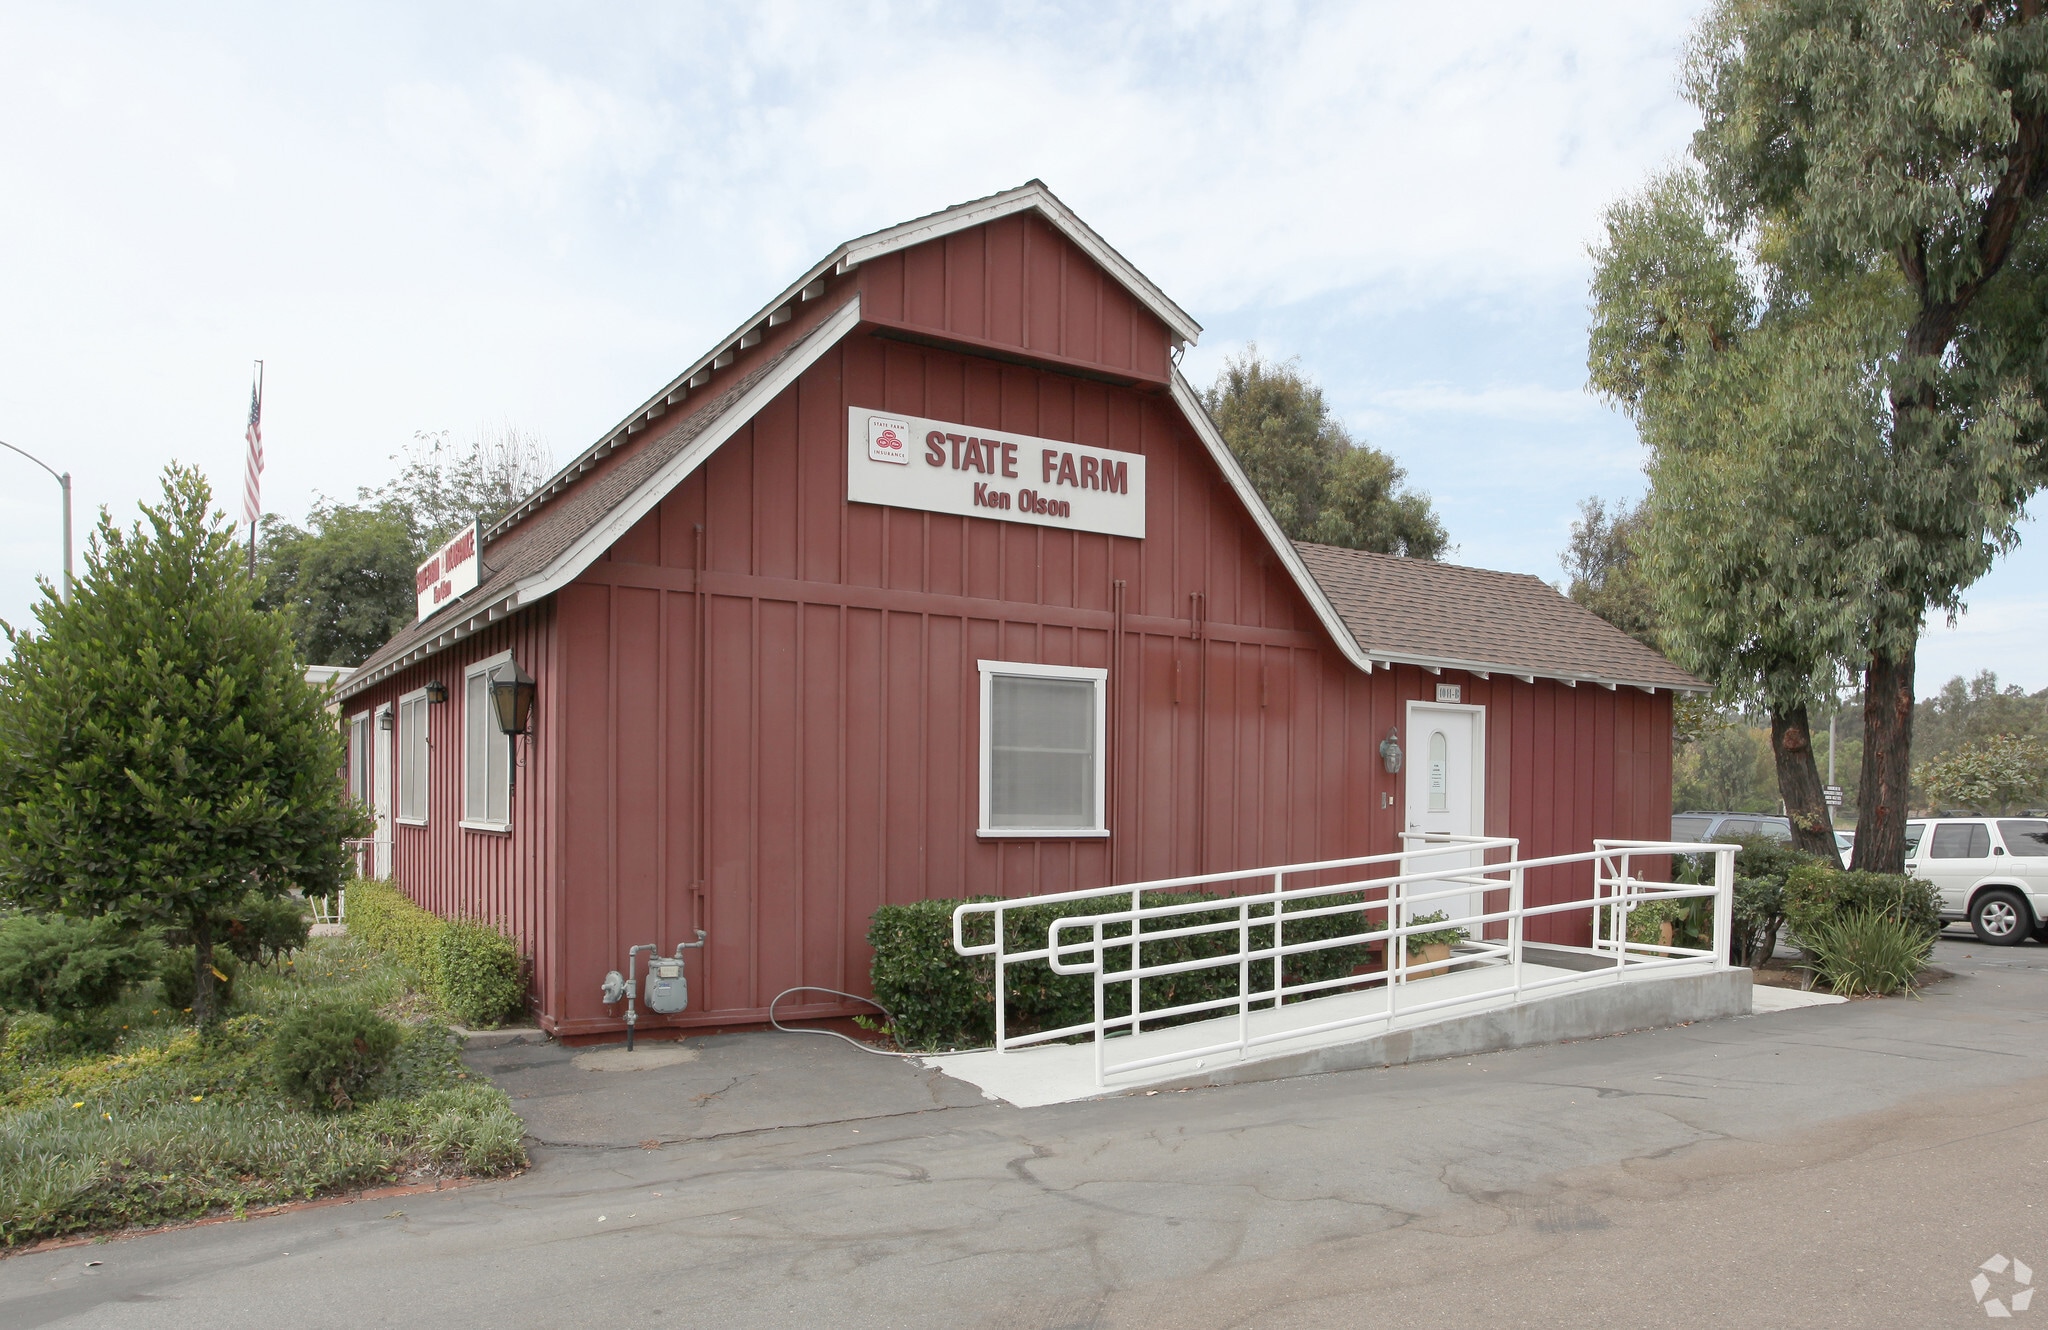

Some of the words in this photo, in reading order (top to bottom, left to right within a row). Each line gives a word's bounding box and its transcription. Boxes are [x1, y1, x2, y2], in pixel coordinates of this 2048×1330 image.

[873, 449, 905, 458] INSURANCE
[925, 430, 1018, 478] STATE
[1042, 449, 1128, 495] FARM
[973, 482, 1011, 510] Ken
[1018, 488, 1070, 518] Olson
